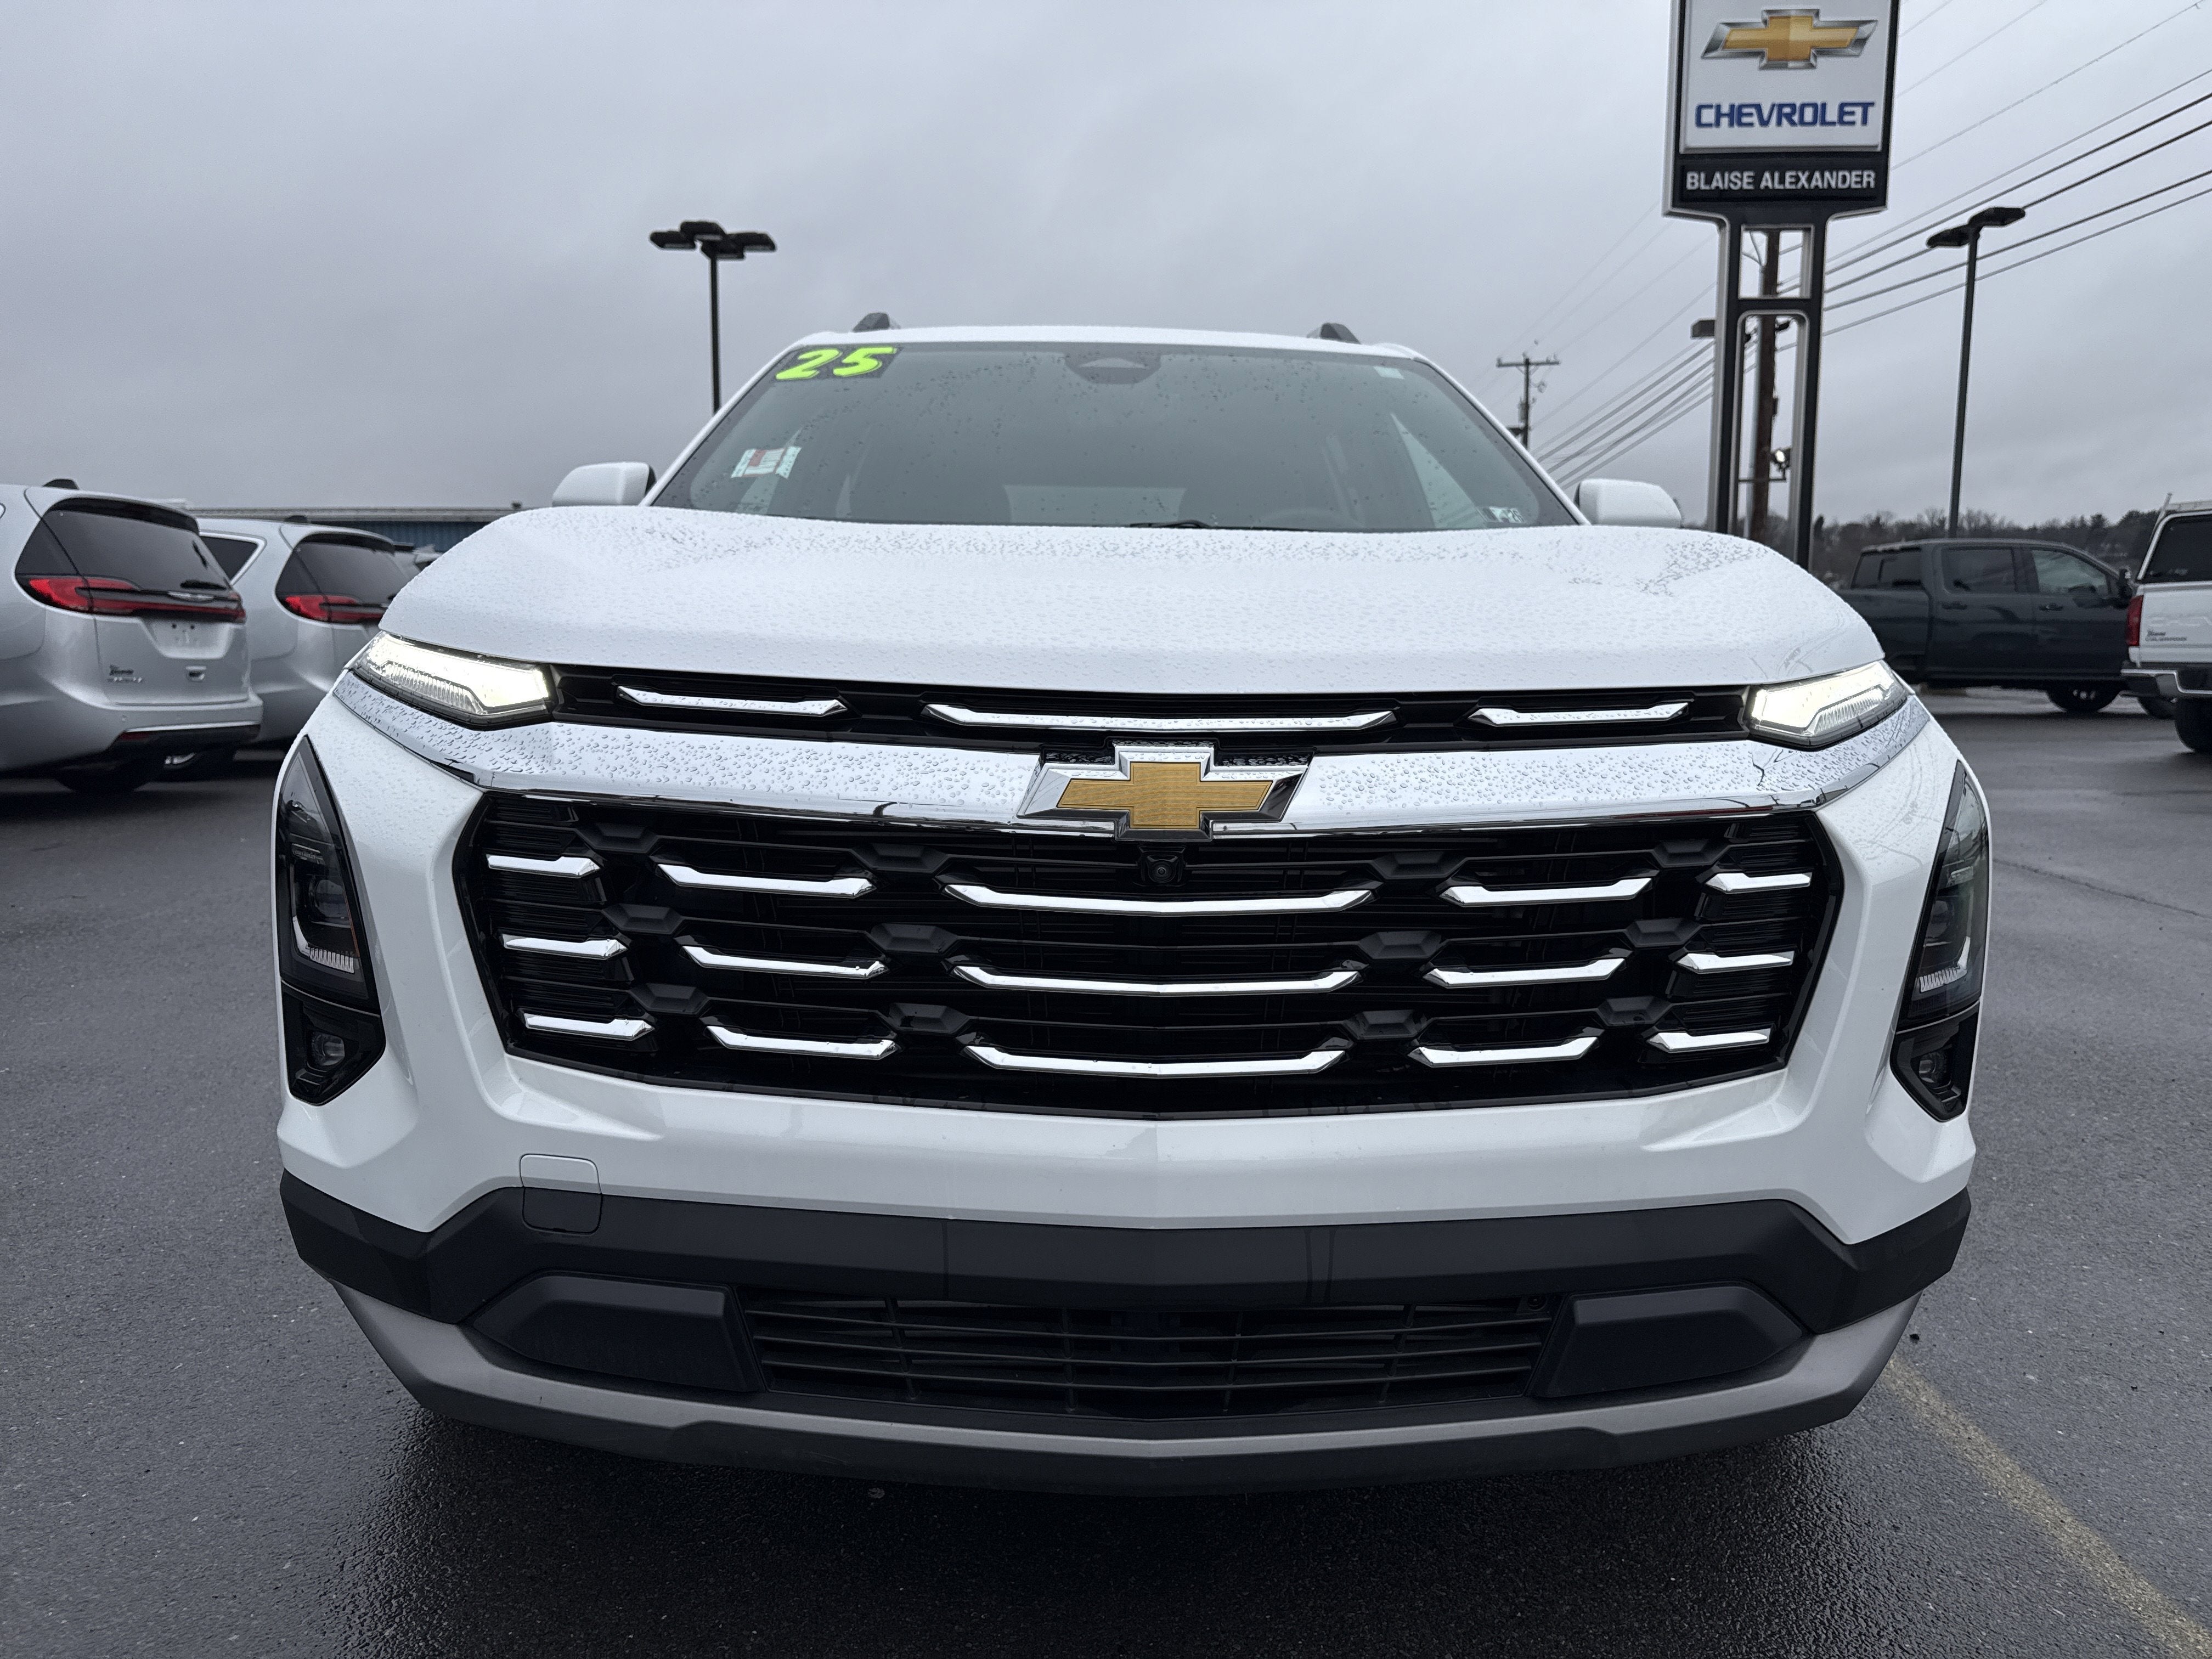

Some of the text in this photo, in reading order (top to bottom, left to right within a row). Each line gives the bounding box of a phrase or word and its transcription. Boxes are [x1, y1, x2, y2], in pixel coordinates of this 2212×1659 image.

[1695, 101, 1875, 128] CHEVROLET
[1686, 170, 1876, 190] BLAISE ALEXANDER
[775, 346, 896, 380] 25
